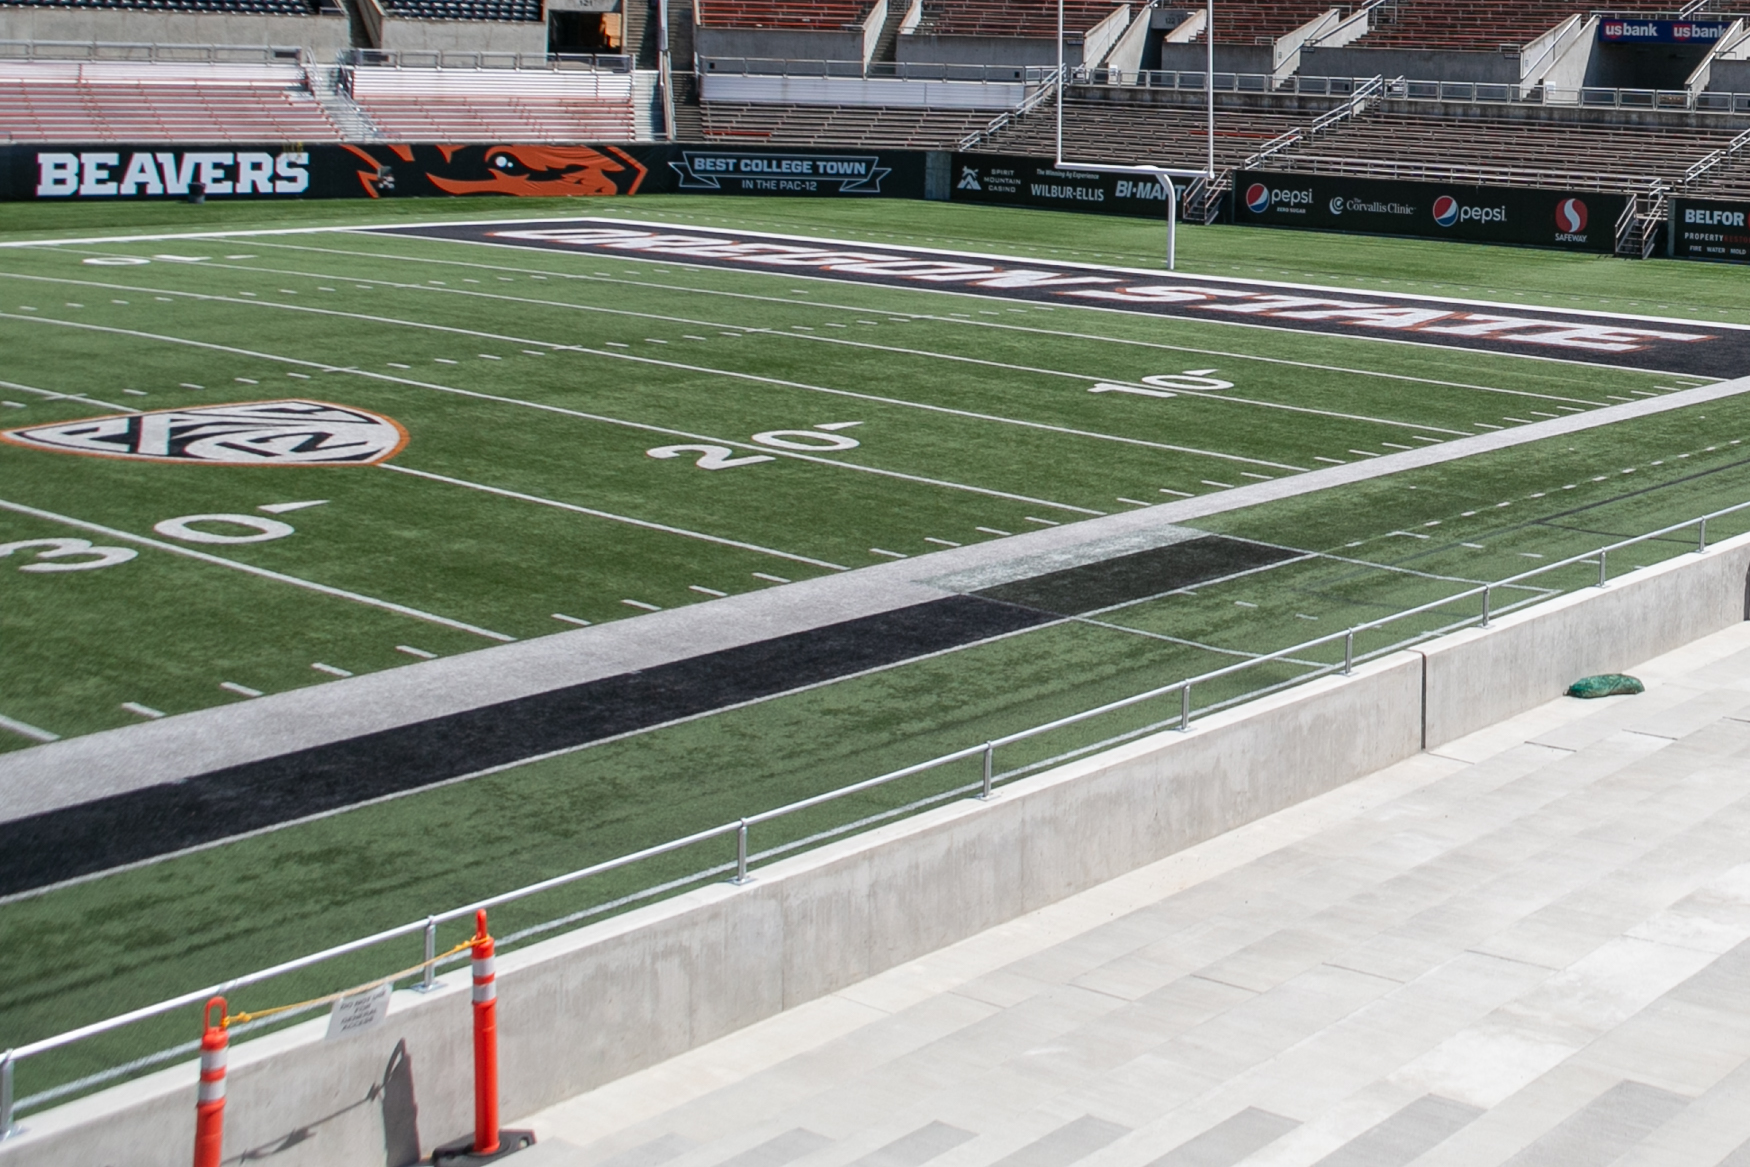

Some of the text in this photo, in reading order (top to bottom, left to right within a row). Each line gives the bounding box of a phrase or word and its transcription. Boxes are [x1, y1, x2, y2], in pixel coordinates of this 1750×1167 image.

[36, 151, 310, 197] BEAVERS
[693, 157, 866, 175] BEST COLLEGE TOWN
[991, 168, 1015, 176] SPIRIT
[741, 179, 817, 191] IN THE PAC-12
[983, 176, 1021, 185] MOUNTAIN
[988, 185, 1016, 193] CASINO
[1030, 183, 1105, 202] WILBUR-ELLIS
[1271, 188, 1313, 206] pepsi
[1346, 200, 1414, 215] Corvallis Clinic
[1460, 205, 1506, 224] pepsi
[1685, 209, 1745, 227] BELFOR
[1554, 233, 1588, 243] SAFEWAY
[1684, 232, 1724, 242] PROPERTY
[1706, 246, 1726, 254] WATER
[485, 228, 1720, 355] OREGON STATE
[646, 429, 860, 471] 20
[0, 513, 295, 573] 30
